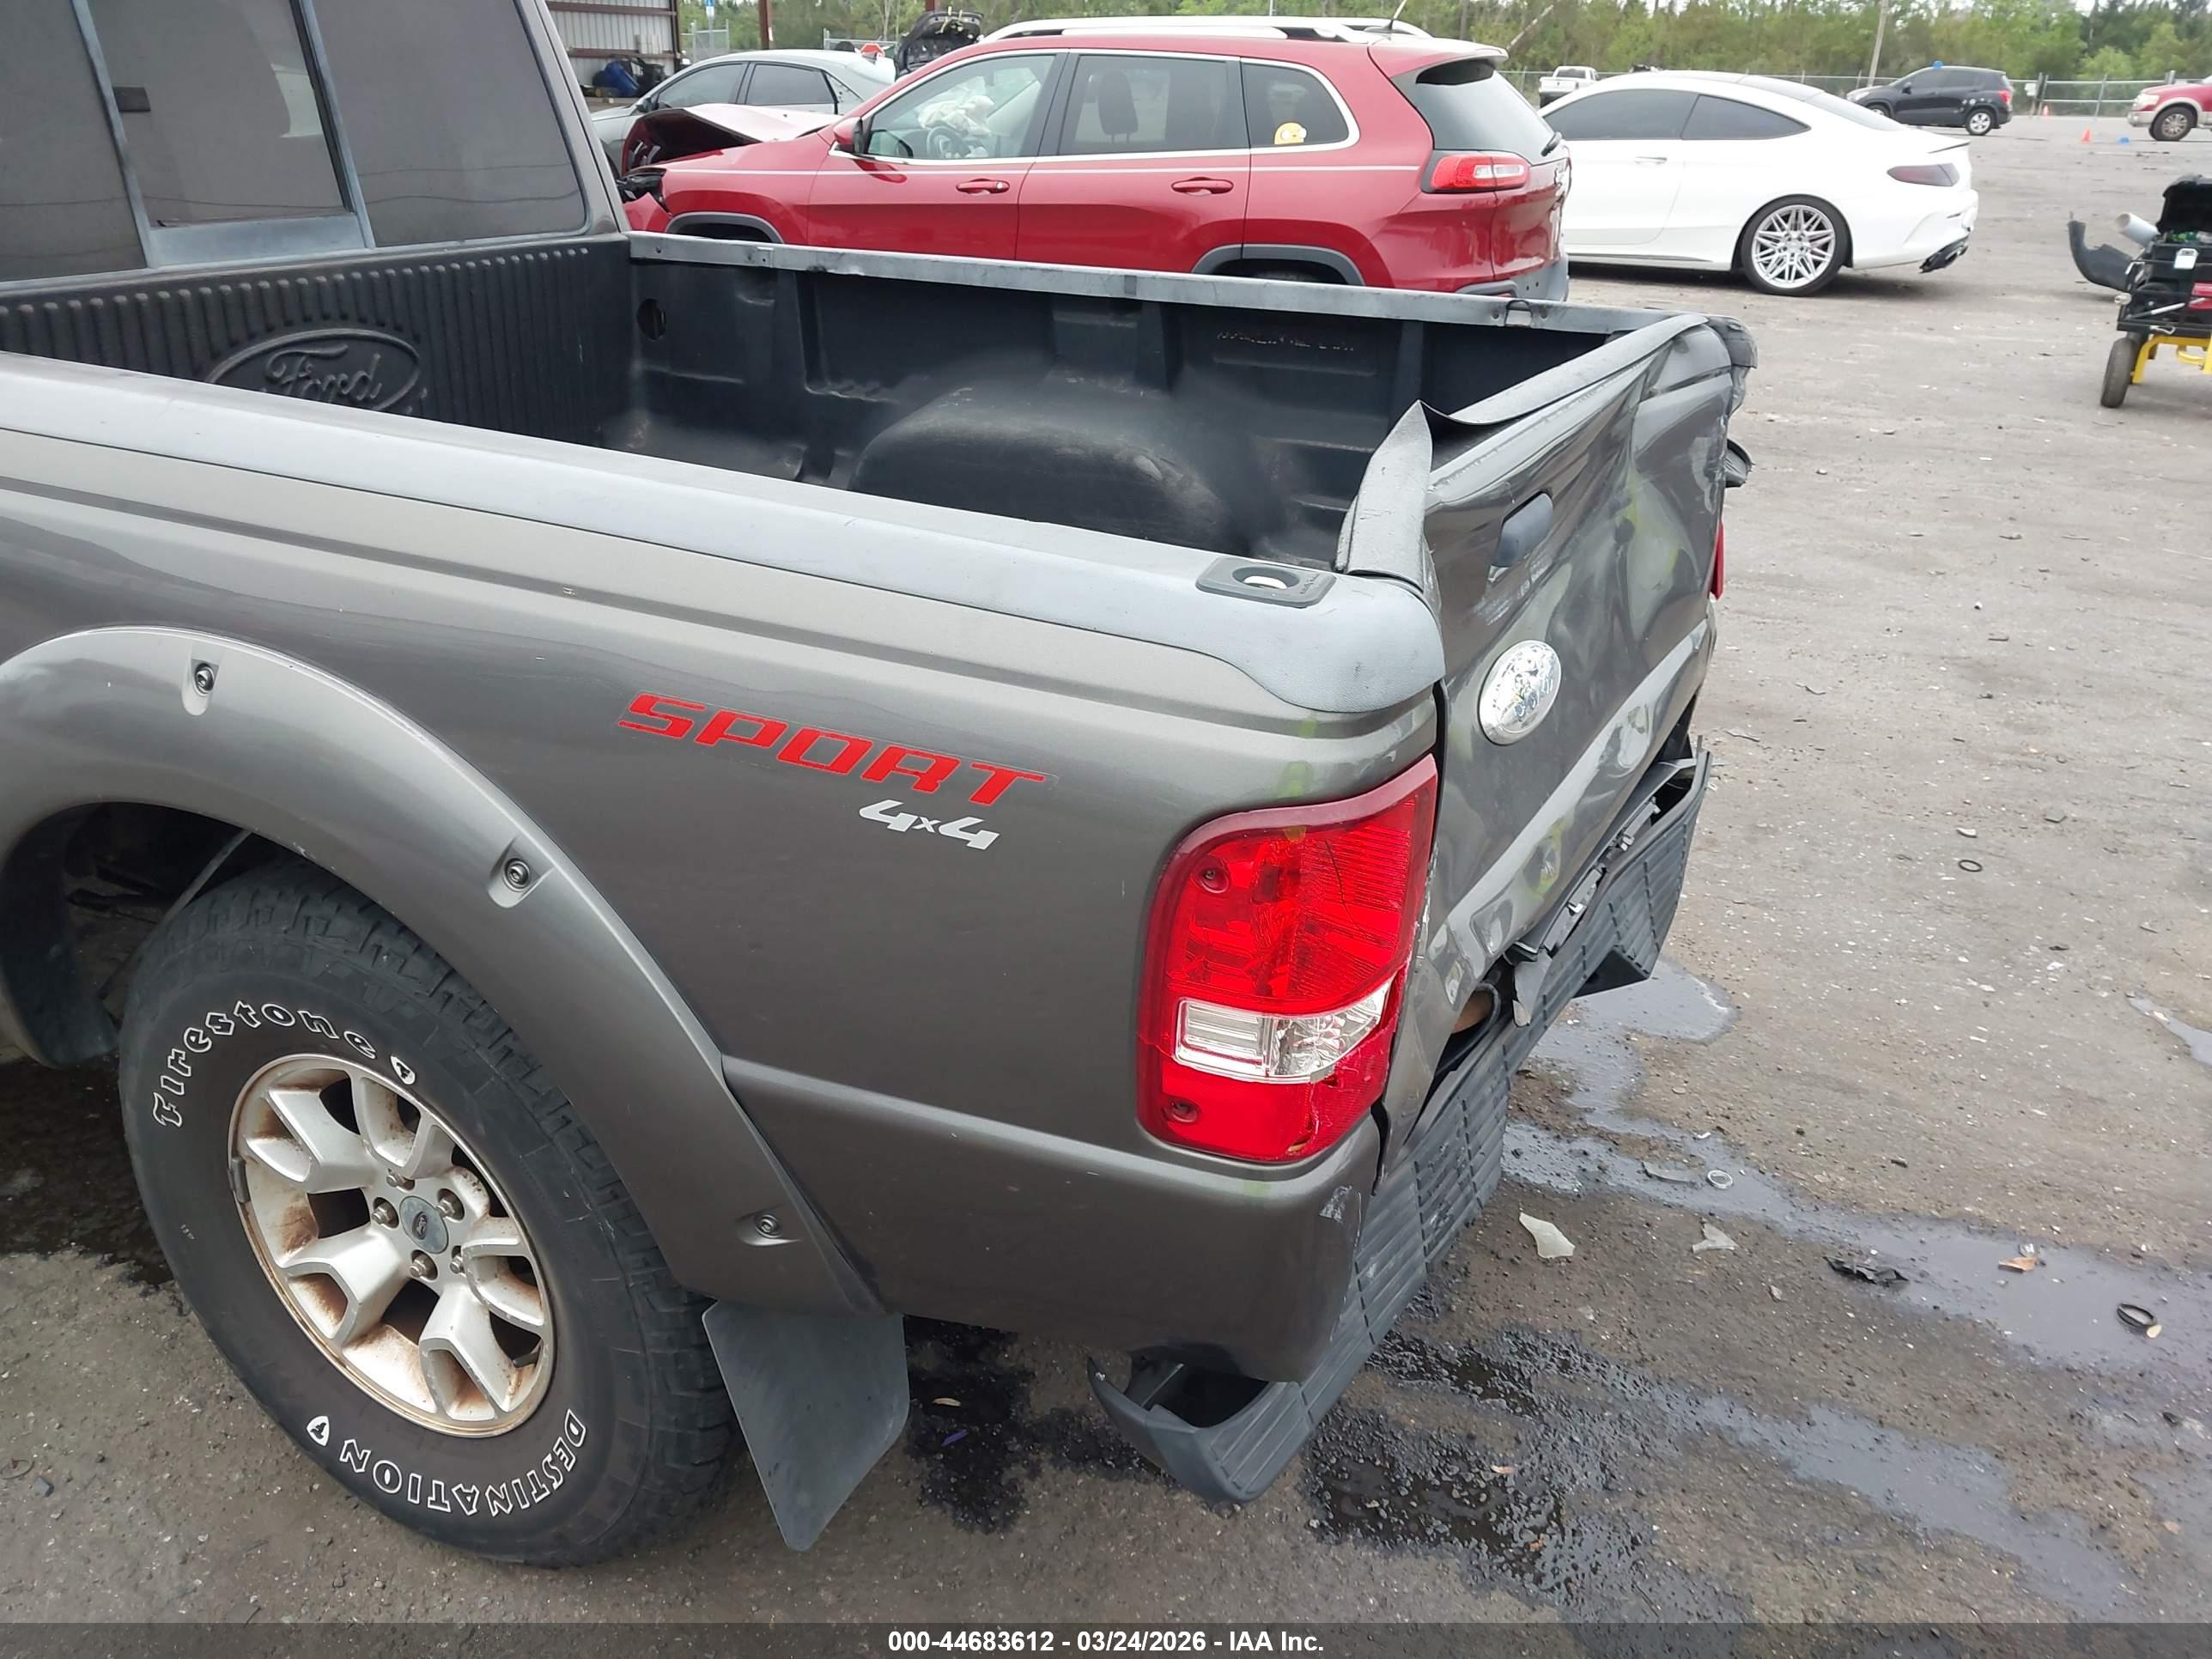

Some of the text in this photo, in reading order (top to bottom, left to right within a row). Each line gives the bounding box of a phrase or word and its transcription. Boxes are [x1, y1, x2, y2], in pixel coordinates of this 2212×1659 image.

[617, 692, 1045, 806] SPORT
[859, 799, 1000, 851] 4x4
[152, 1000, 378, 1127] Firestone
[339, 1407, 586, 1517] DESTINATION
